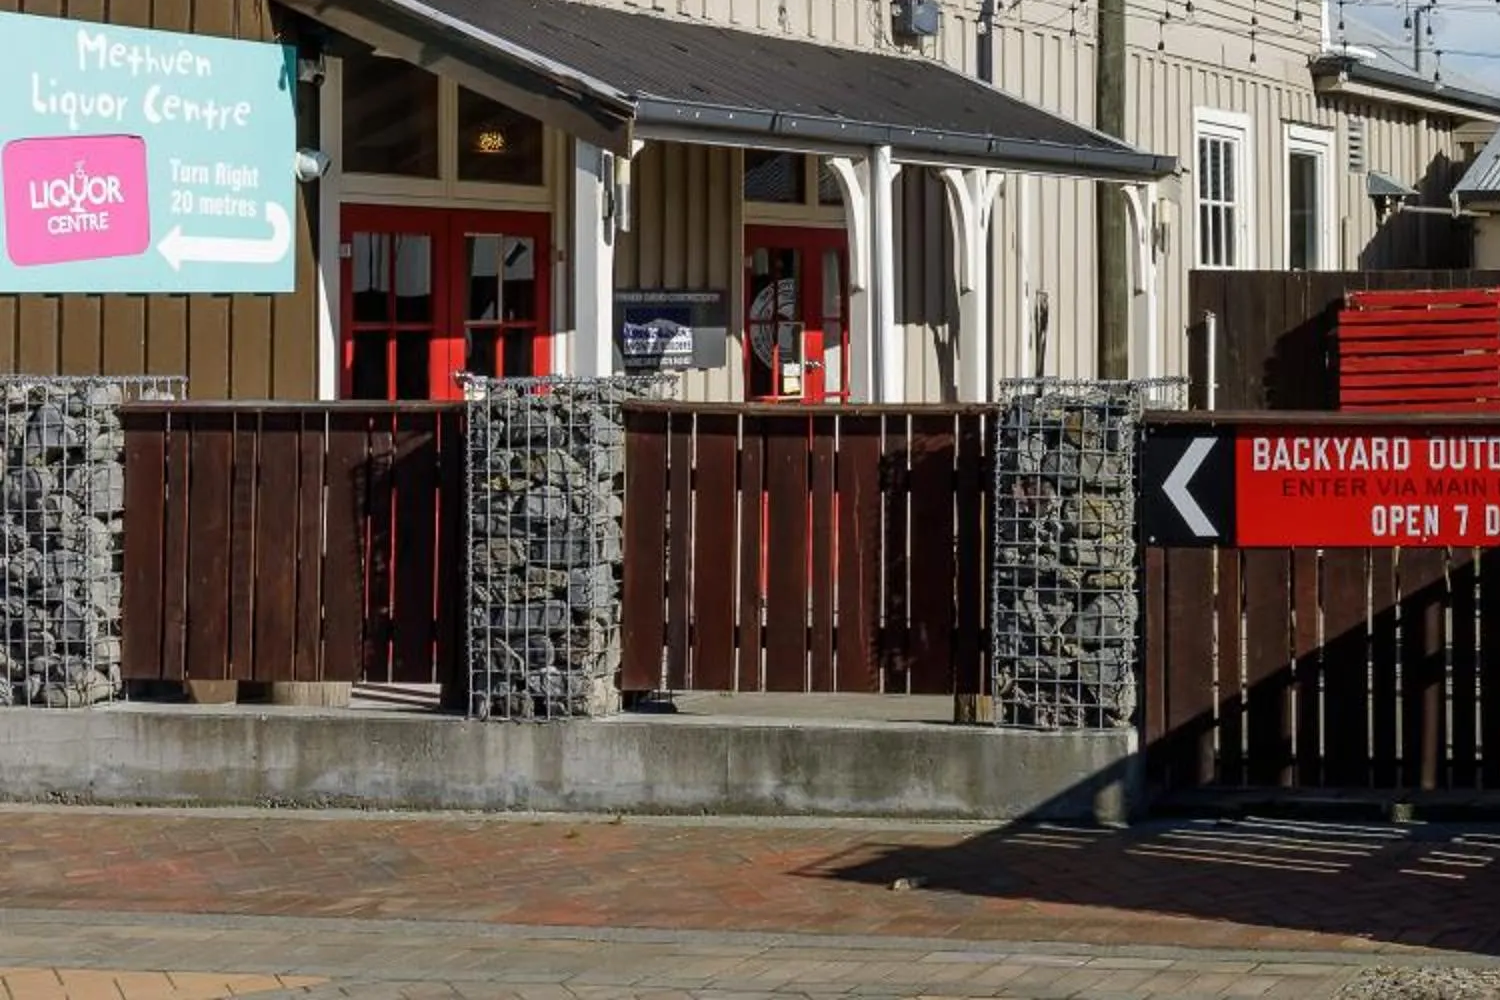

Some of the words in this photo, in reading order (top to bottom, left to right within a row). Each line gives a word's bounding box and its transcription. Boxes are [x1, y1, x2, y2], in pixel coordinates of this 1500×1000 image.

[76, 28, 212, 77] Methven
[31, 72, 129, 130] Liquor
[143, 84, 251, 130] Centre
[170, 159, 208, 186] Turn
[215, 162, 259, 191] Right
[29, 172, 124, 213] LIQUOR
[171, 190, 193, 216] 20
[200, 194, 257, 218] metres
[48, 212, 109, 235] CENTRE
[1252, 437, 1410, 472] BACKYARD
[1282, 476, 1368, 498] ENTER
[1377, 476, 1418, 498] VIA
[1427, 476, 1487, 498] MAIN
[1371, 505, 1439, 537] OPEN
[1453, 504, 1469, 536] 7
